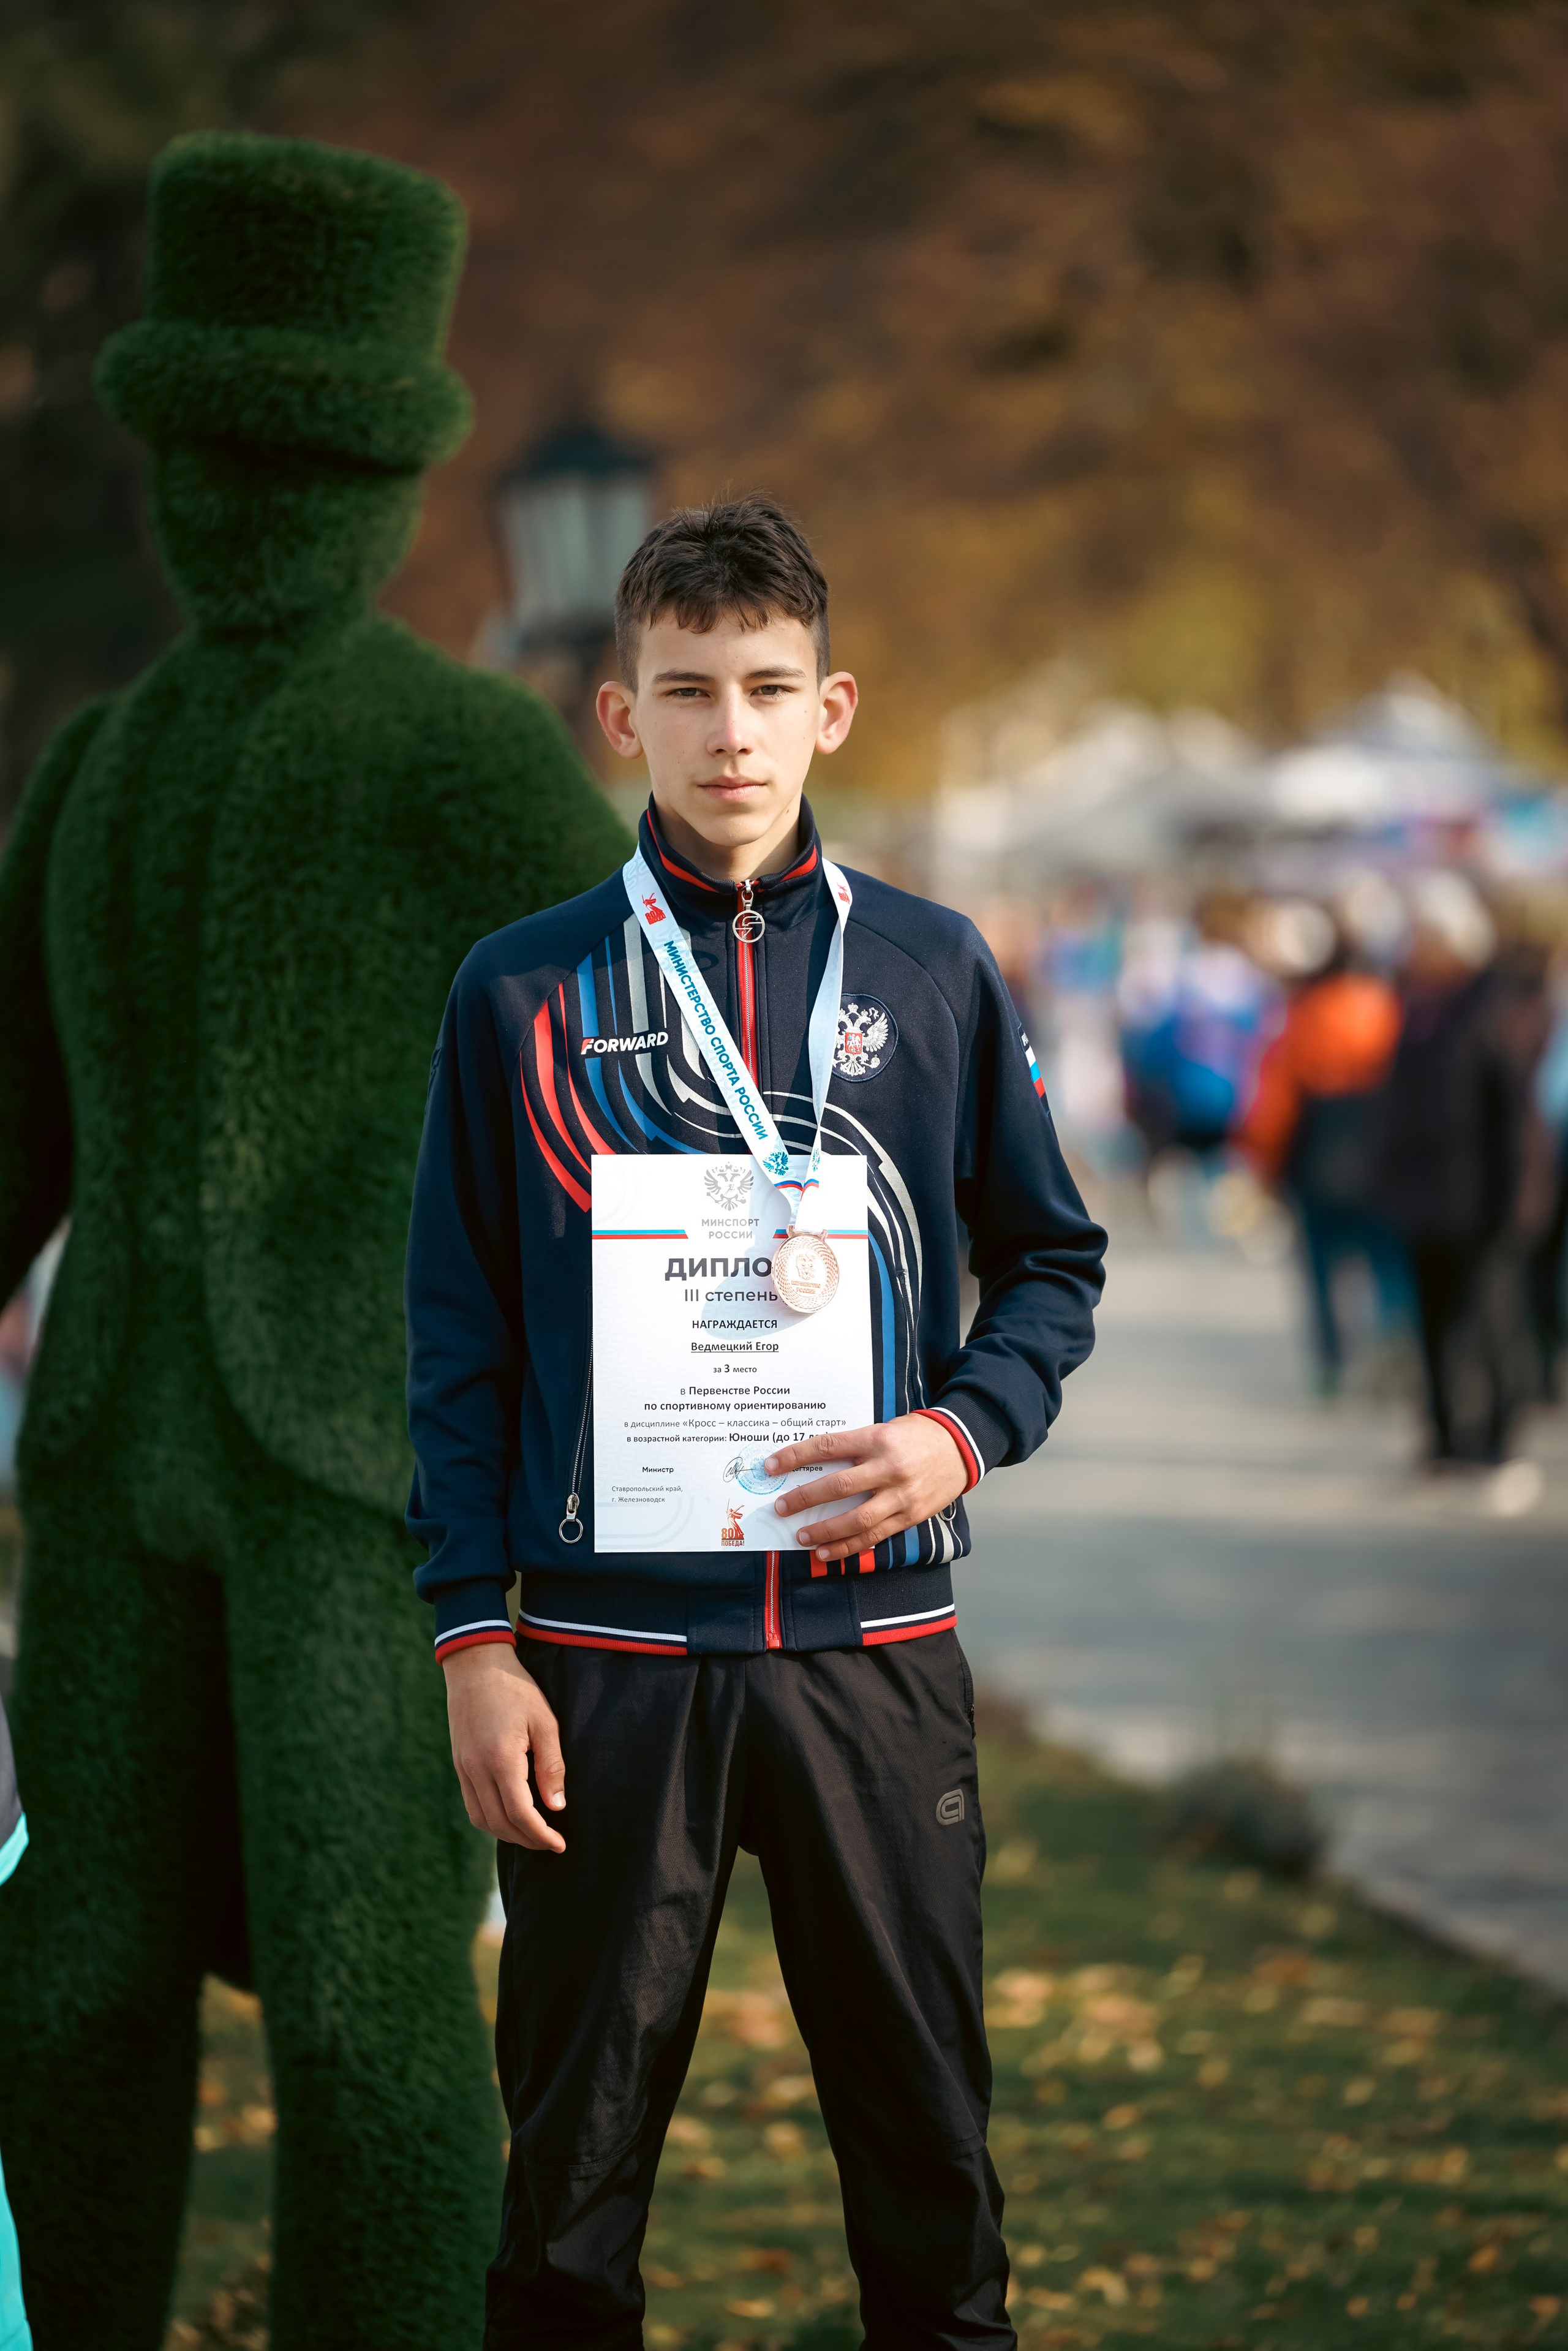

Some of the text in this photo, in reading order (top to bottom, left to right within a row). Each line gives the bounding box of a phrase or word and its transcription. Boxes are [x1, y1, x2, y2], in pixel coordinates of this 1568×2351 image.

[581, 1032, 669, 1055] FORWARD
[663, 940, 768, 1140] МИНИСТЕРСТВО СПОРТА РОССИИ
[701, 1218, 760, 1227] МИНСПОРТ
[709, 1231, 753, 1239] РОССИИ
[665, 1257, 772, 1281] ДИПЛО
[706, 1289, 778, 1302] степень
[692, 1319, 777, 1331] НАГРАЖДАЕТСЯ
[691, 1342, 778, 1352] Ведмецкий Егор
[724, 1364, 730, 1373] 3
[689, 1386, 750, 1395] Первенстве
[753, 1386, 790, 1395] России
[660, 1403, 731, 1412] спортивному
[734, 1402, 826, 1411] ориентированию
[683, 1419, 717, 1428] «Кросс
[780, 1417, 813, 1428] общий
[816, 1419, 846, 1428] старт»
[633, 1435, 680, 1443] возрастной
[729, 1433, 769, 1442] Юноши
[772, 1432, 790, 1443] (до
[793, 1432, 805, 1441] 17
[721, 1527, 734, 1539] 80
